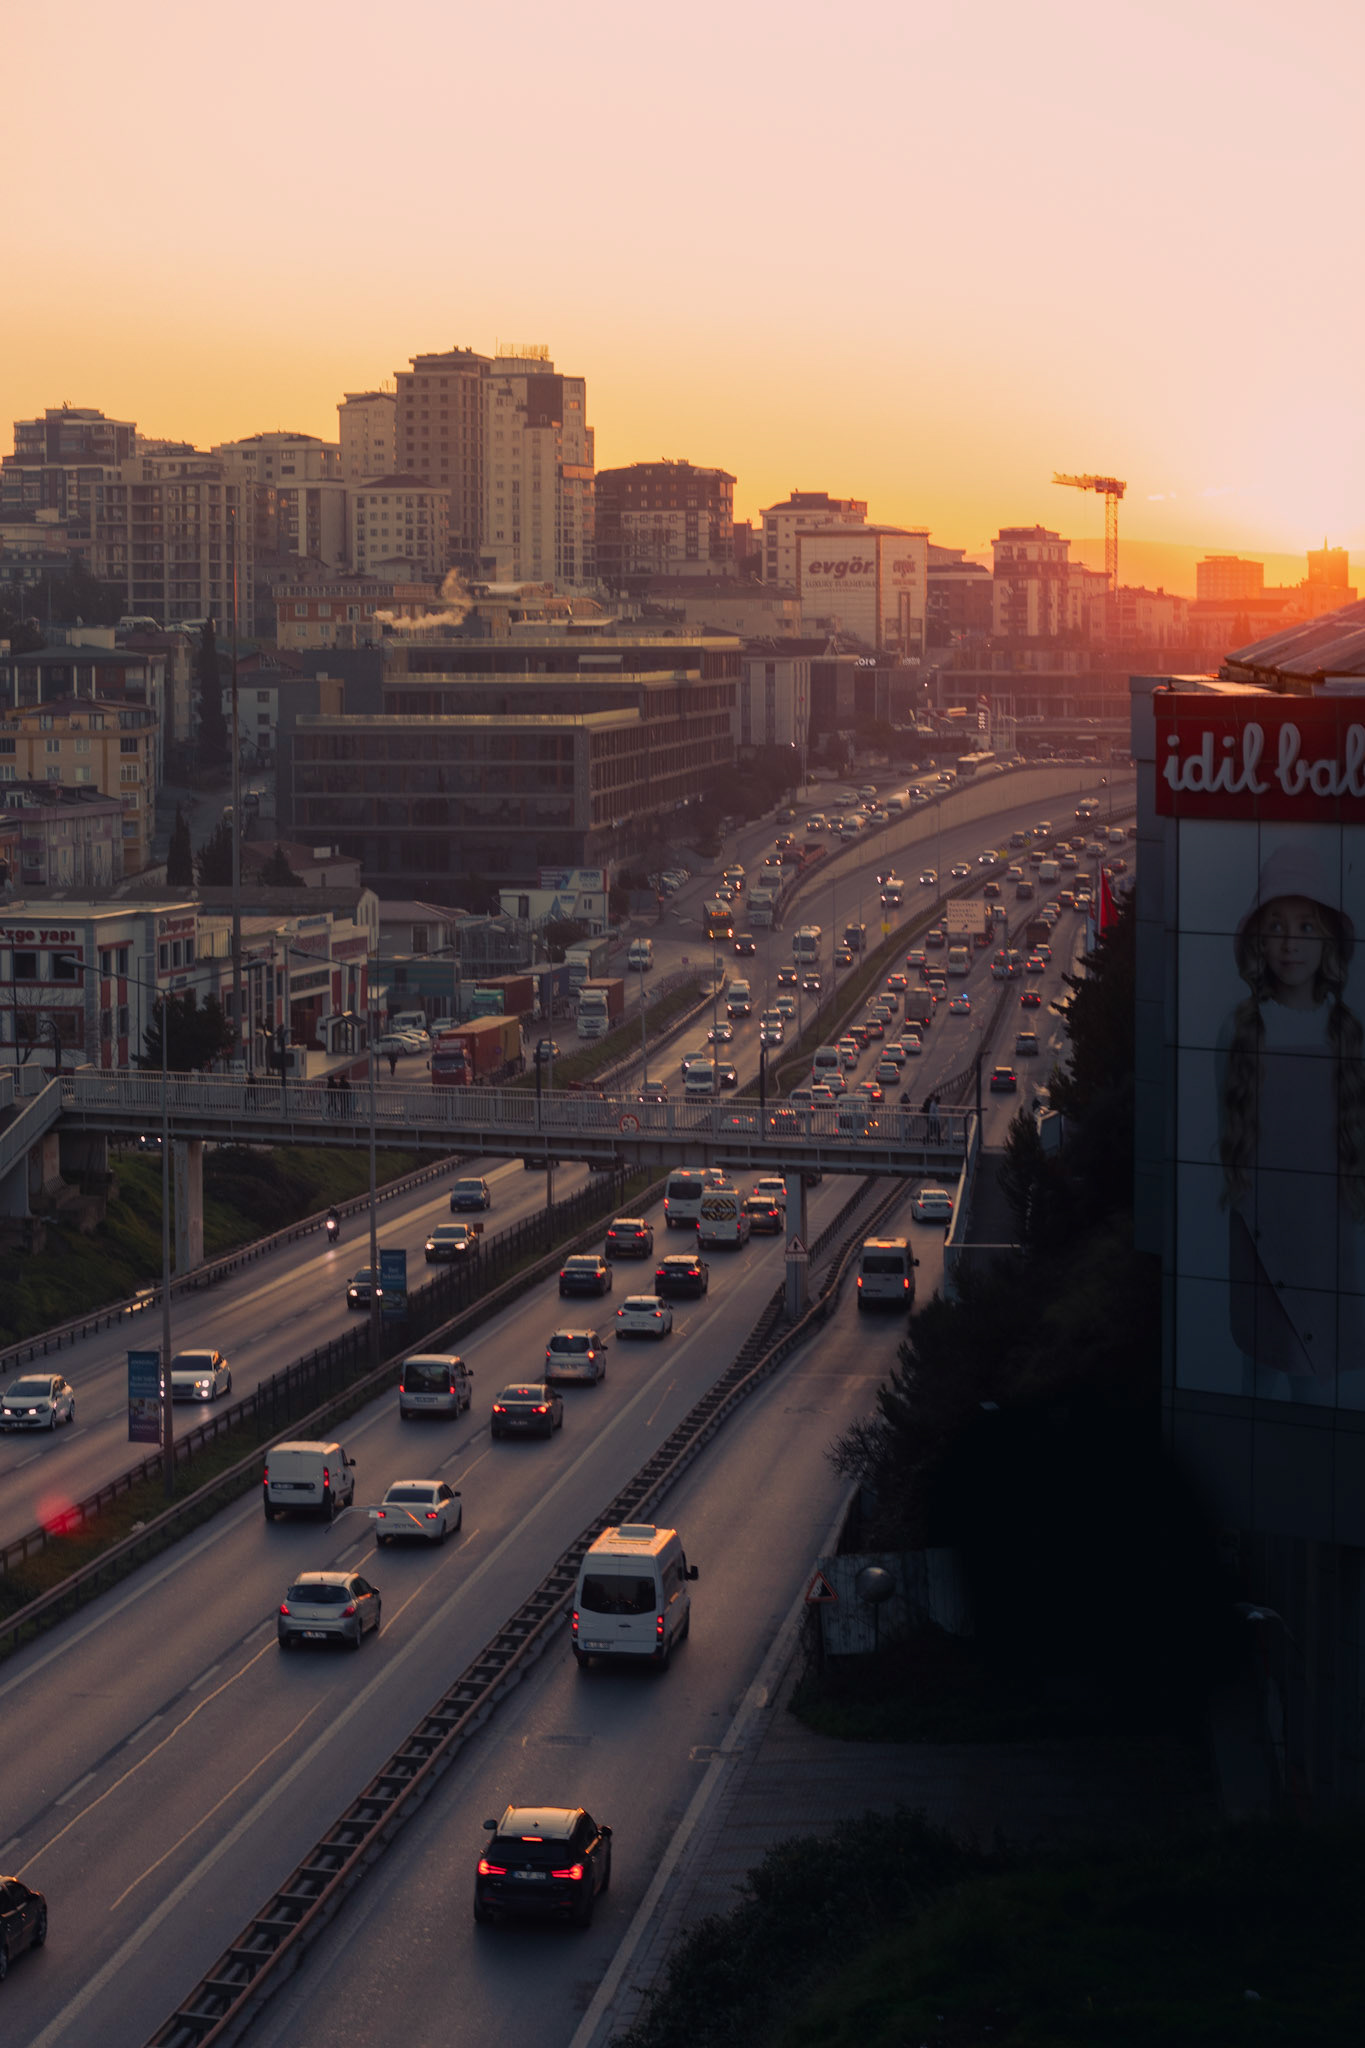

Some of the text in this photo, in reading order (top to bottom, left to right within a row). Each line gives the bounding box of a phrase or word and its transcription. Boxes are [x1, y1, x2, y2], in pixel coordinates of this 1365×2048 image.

[809, 556, 874, 579] evgör
[1163, 722, 1365, 798] idil bal
[39, 929, 76, 944] yapı
